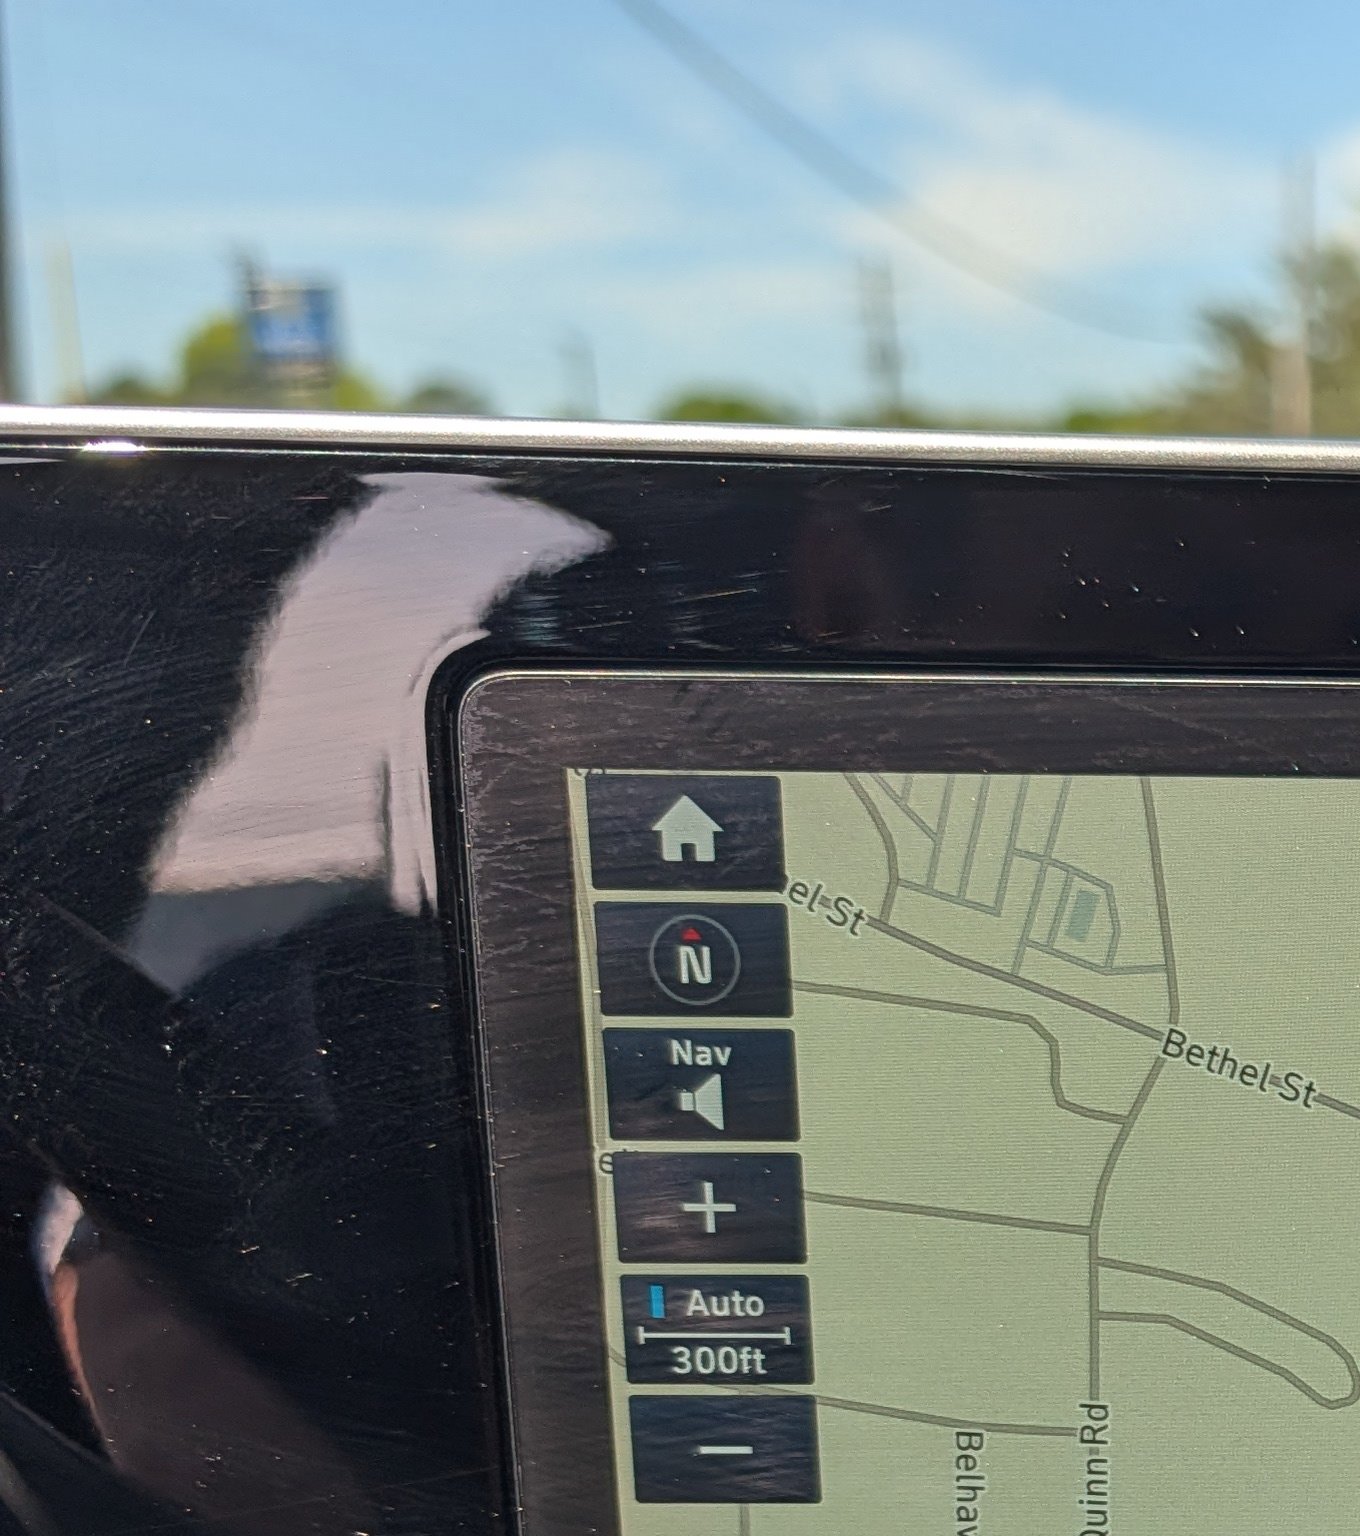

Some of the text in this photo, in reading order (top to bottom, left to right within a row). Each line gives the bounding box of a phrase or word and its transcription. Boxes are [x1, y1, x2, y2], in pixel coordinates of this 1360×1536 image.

[826, 896, 866, 936] St
[679, 944, 712, 985] N
[671, 1039, 731, 1066] Nav
[1162, 1028, 1317, 1108] Bethel St
[685, 1290, 765, 1318] Auto
[672, 1346, 767, 1375] 300ft
[1078, 1403, 1109, 1444] Rd
